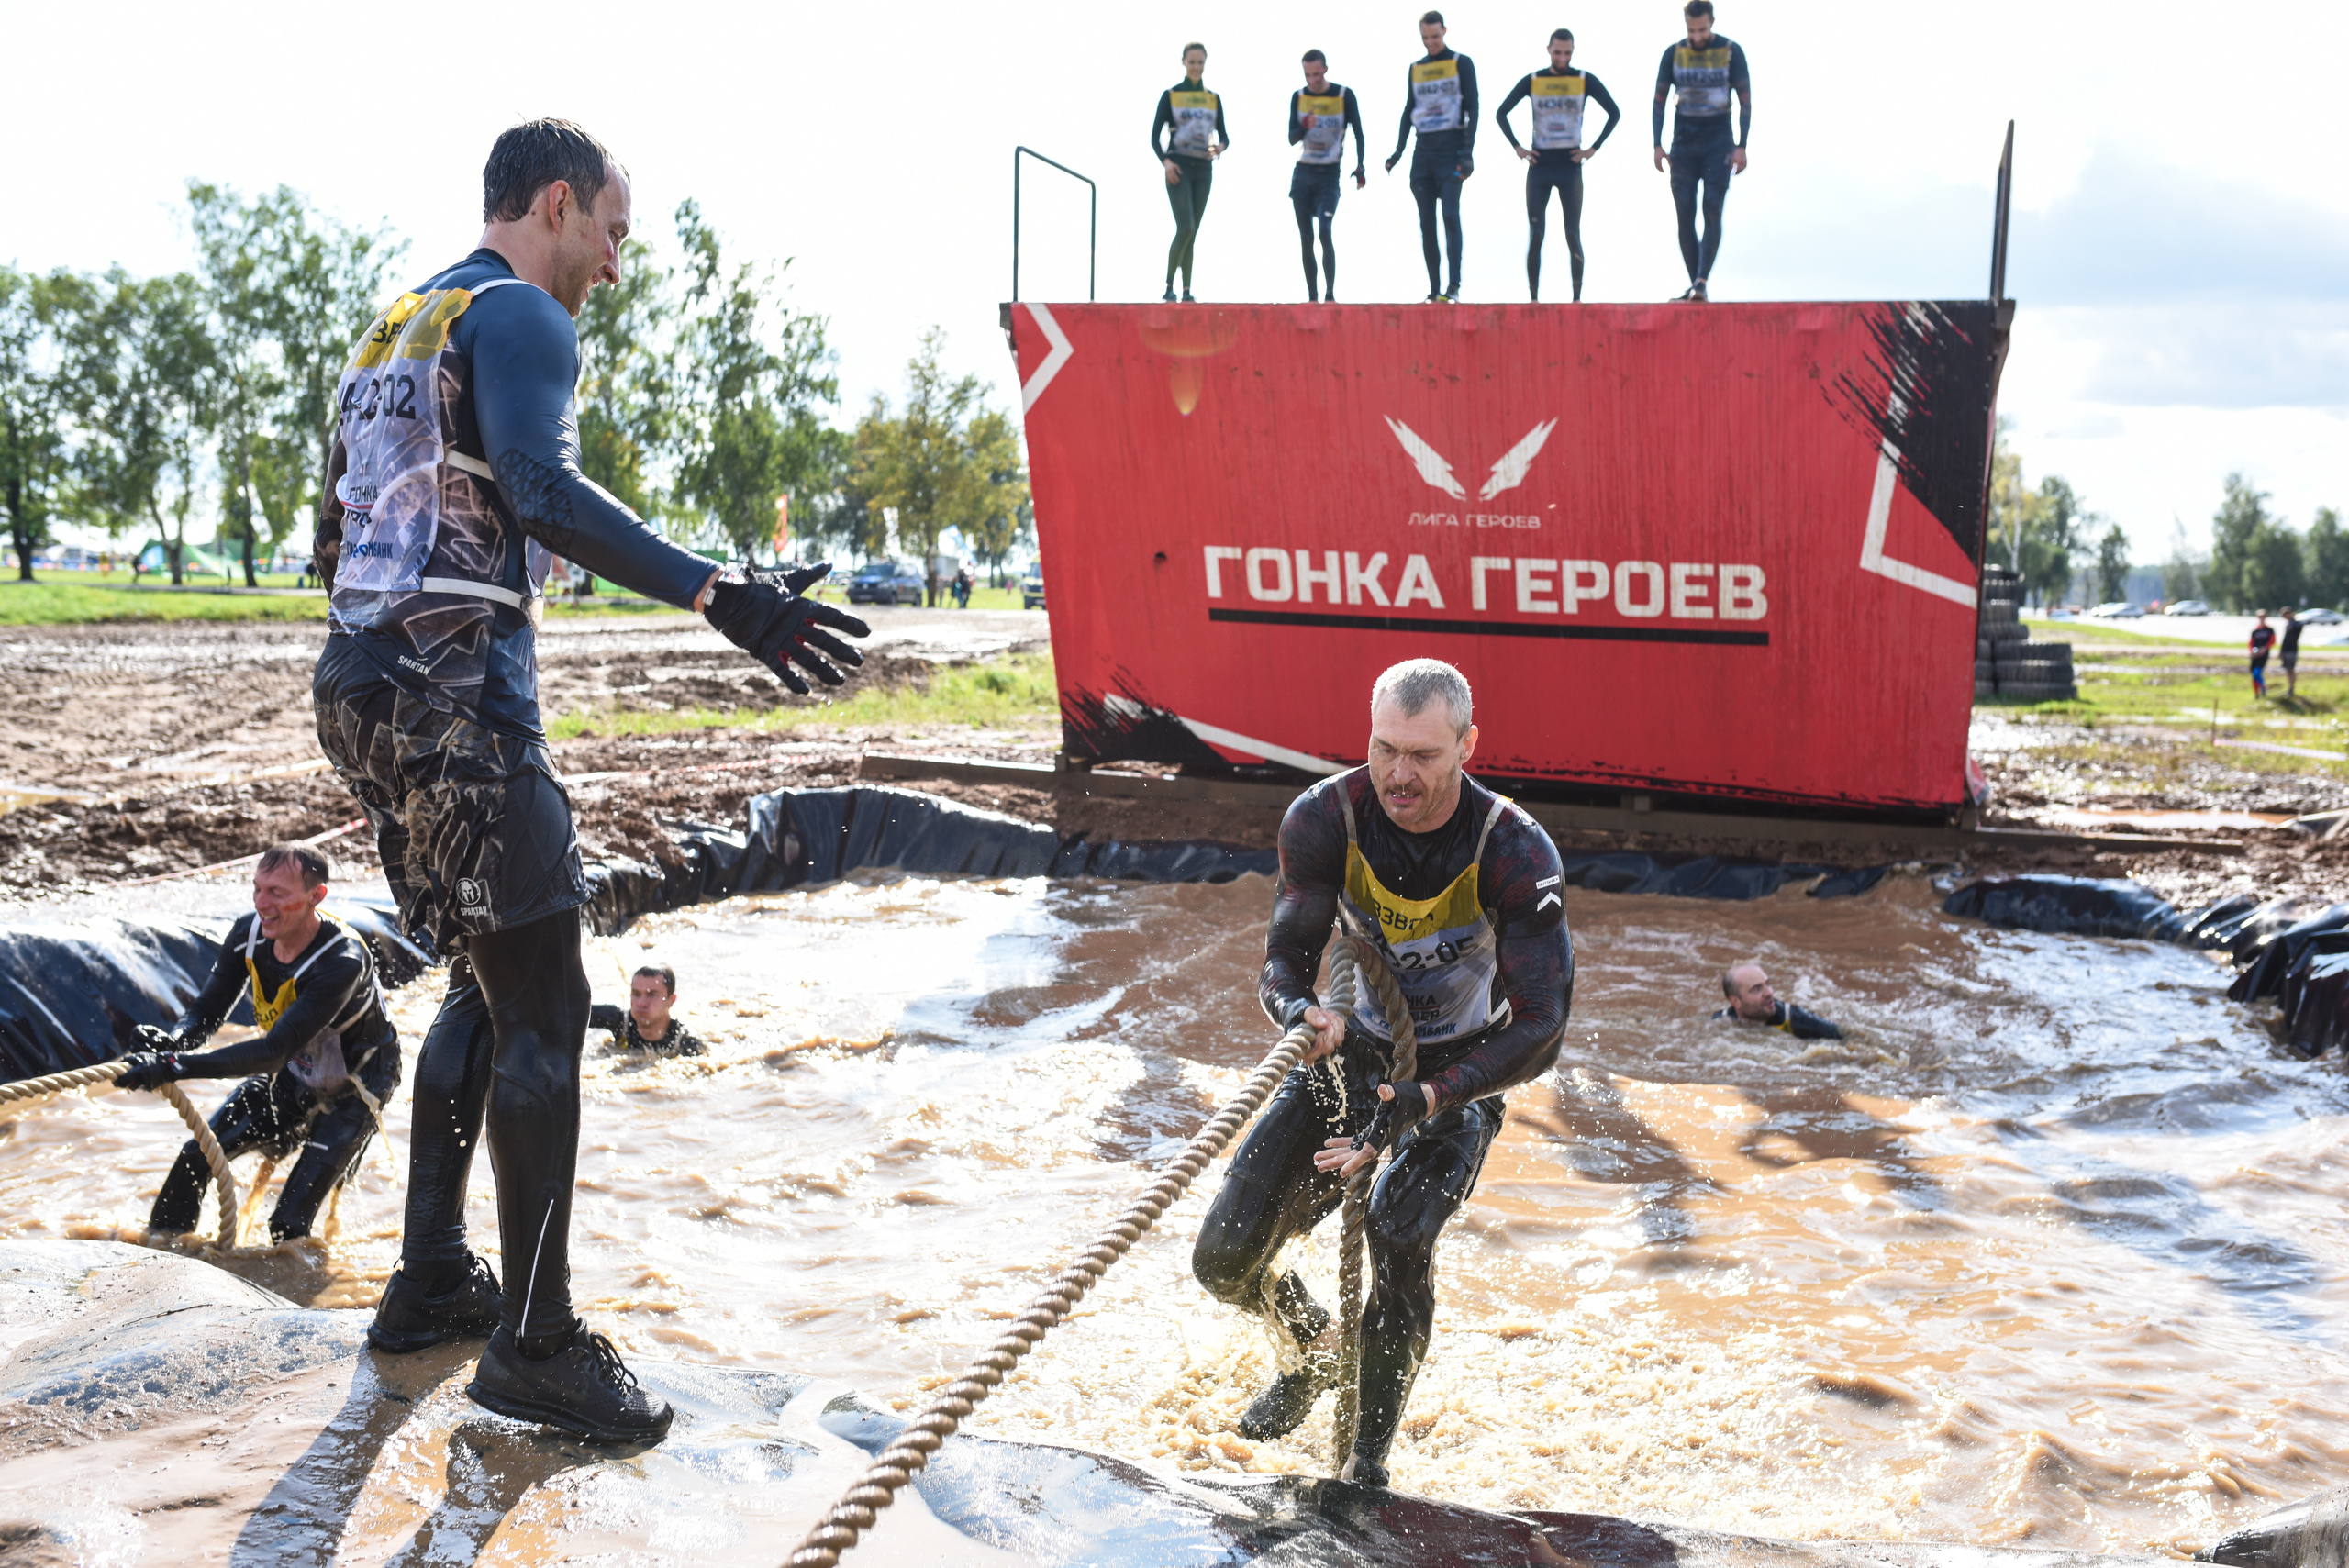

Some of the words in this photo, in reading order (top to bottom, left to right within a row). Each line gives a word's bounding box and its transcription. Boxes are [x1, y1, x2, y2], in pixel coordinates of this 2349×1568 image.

[1408, 512, 1460, 527] ЛИГА
[1466, 514, 1541, 529] ГЕРОЕВ
[1204, 545, 1446, 609] ГОНКА
[1471, 556, 1768, 620] ГЕРОЕВ
[397, 654, 430, 676] SPARTAN
[460, 906, 487, 917] SPARTAN
